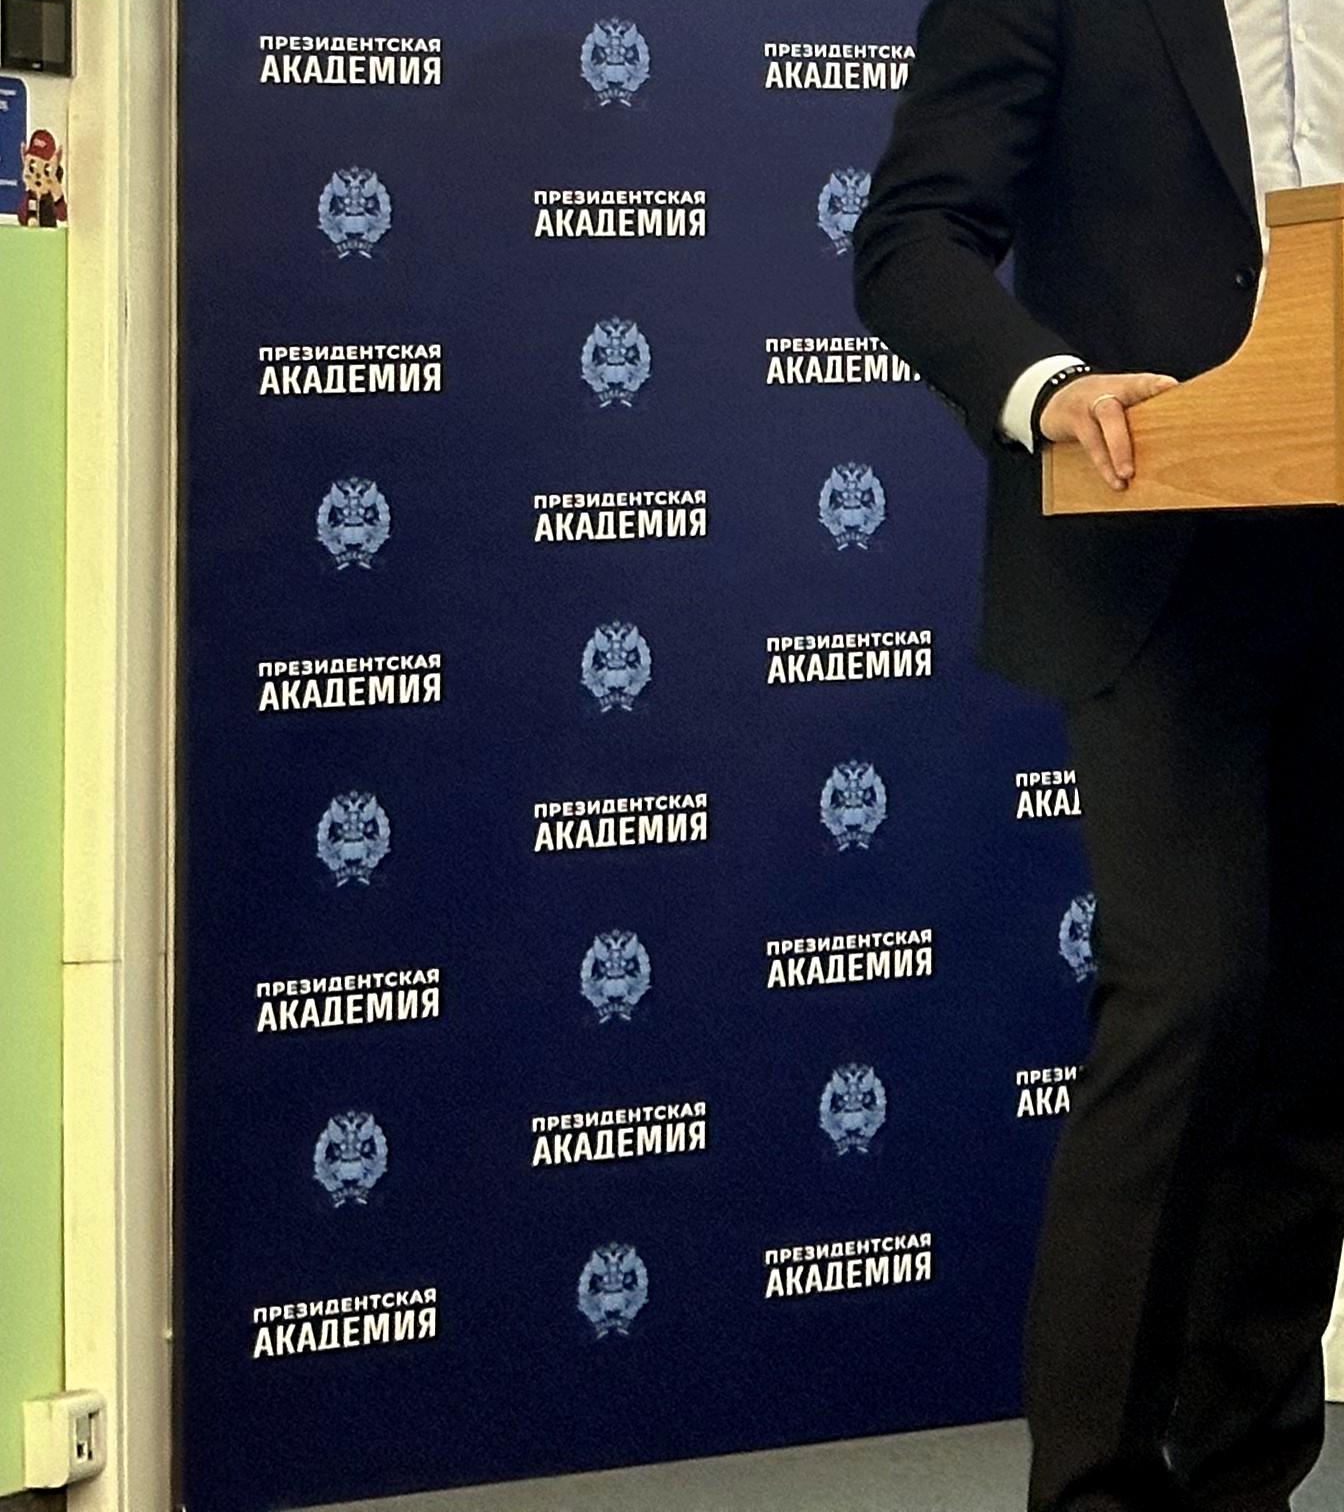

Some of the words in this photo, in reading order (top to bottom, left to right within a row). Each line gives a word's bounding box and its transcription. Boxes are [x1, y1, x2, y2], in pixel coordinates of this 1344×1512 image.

[260, 36, 440, 52] ПРЕЗИДЕНТСКАЯ
[765, 44, 915, 59] ПРЕЗИДЕНТСКА
[261, 55, 440, 84] АКАДЕМИЯ
[766, 62, 908, 89] АКАДЕМИ
[534, 191, 705, 204] ПРЕЗИДЕНТСКАЯ
[535, 209, 705, 236] АКАДЕМИЯ
[259, 345, 440, 361] ПРЕЗИДЕНТСКАЯ
[260, 363, 440, 395] АКАДЕМИЯ
[534, 490, 706, 509] ПРЕЗИДЕНТСКАЯ
[535, 508, 706, 542] АКАДЕМИЯ
[767, 631, 931, 651] ПРЕЗИДЕНТСКАЯ
[259, 654, 440, 677] ПРЕЗИДЕНТСКАЯ
[768, 648, 931, 684] АКАДЕМИЯ
[259, 673, 440, 711] АКАДЕМИЯ
[535, 794, 706, 818] ПРЕЗИДЕНТСКАЯ
[535, 812, 706, 852] АКАДЕМИЯ
[767, 929, 931, 956] ПРЕЗИДЕНТСКАЯ
[768, 947, 931, 988] АКАДЕМИЯ
[257, 969, 439, 997] ПРЕЗИДЕНТСКАЯ
[257, 988, 439, 1032] АКАДЕМИЯ
[532, 1102, 705, 1132] ПРЕЗИДЕНТСКАЯ
[533, 1121, 705, 1166] АКАДЕМИЯ
[765, 1233, 931, 1264] ПРЕЗИДЕНТСКАЯ
[766, 1251, 931, 1298] АКАДЕМИЯ
[254, 1288, 436, 1323] ПРЕЗИДЕНТСКАЯ
[253, 1307, 436, 1358] АКАДЕМИЯ
